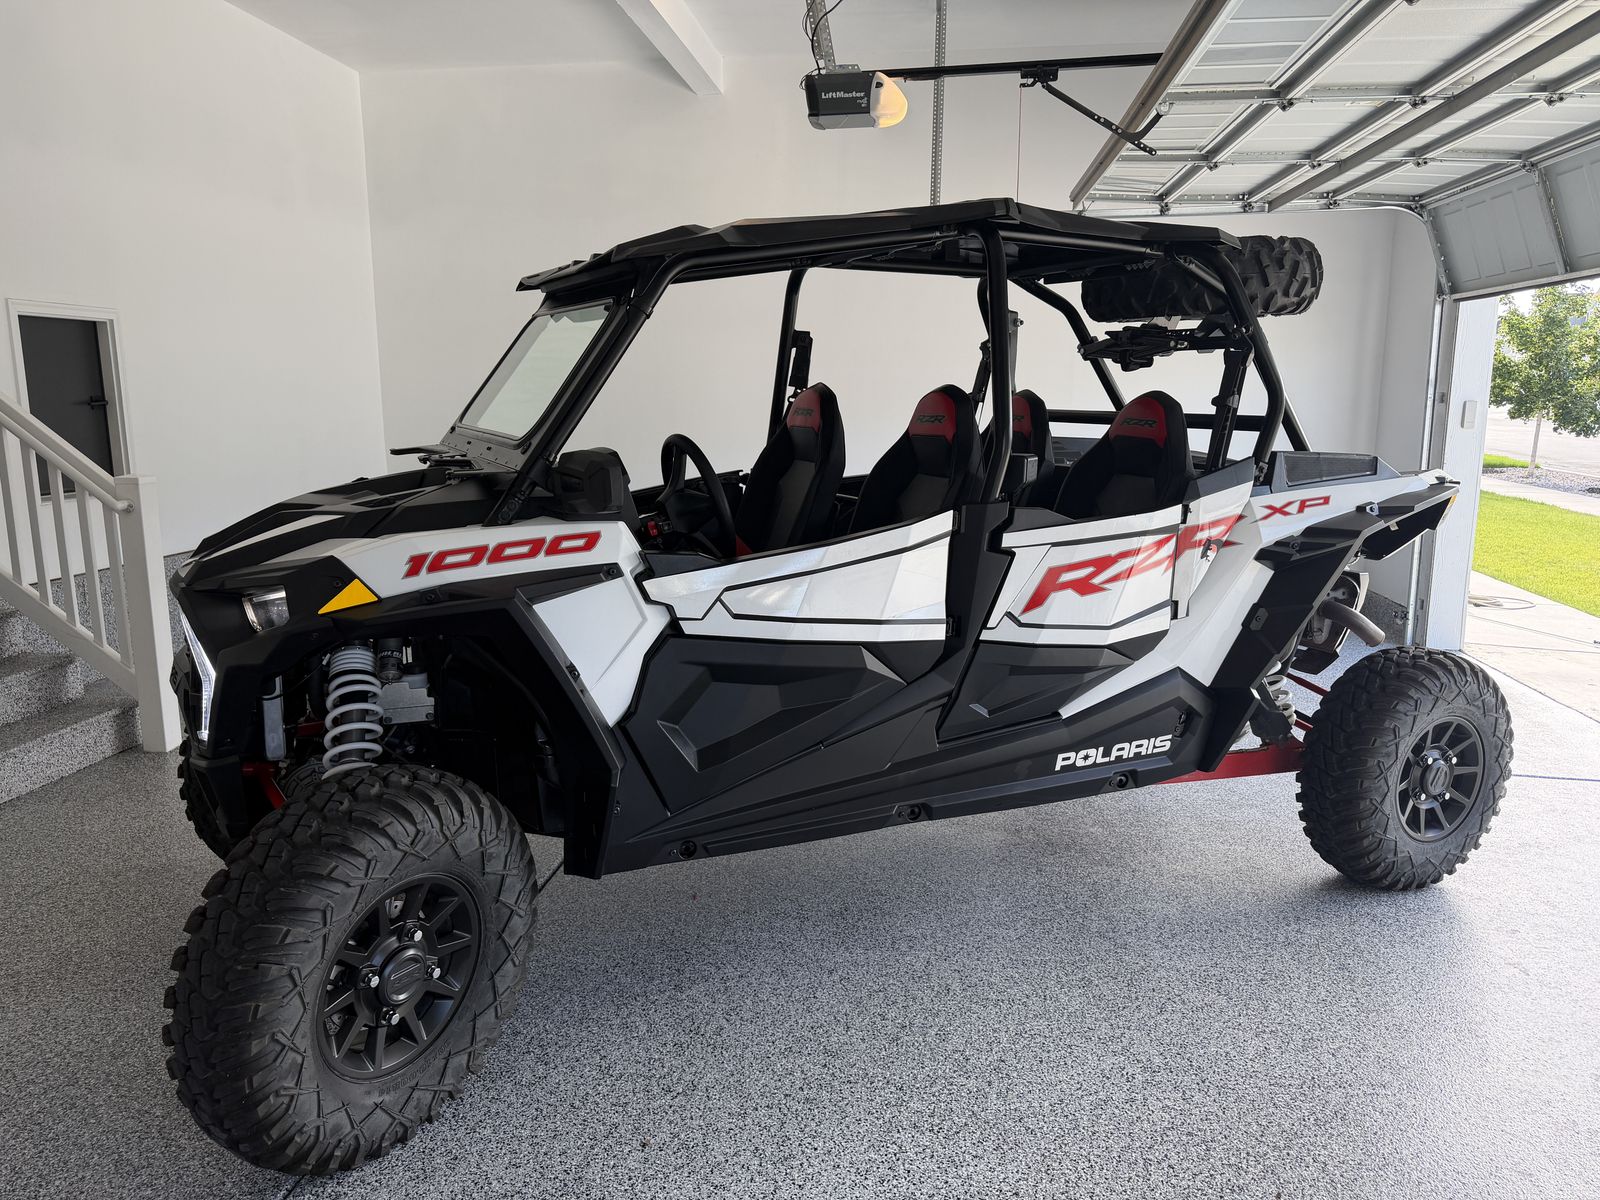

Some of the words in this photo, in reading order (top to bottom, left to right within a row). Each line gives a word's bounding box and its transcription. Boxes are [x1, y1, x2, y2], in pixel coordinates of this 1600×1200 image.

[821, 91, 866, 99] LiftMaster
[915, 415, 946, 424] RZR
[1120, 418, 1158, 428] RZR
[402, 530, 602, 579] 1000
[1018, 513, 1248, 616] RZR
[1251, 495, 1331, 524] XP
[1054, 734, 1173, 771] POLARIS
